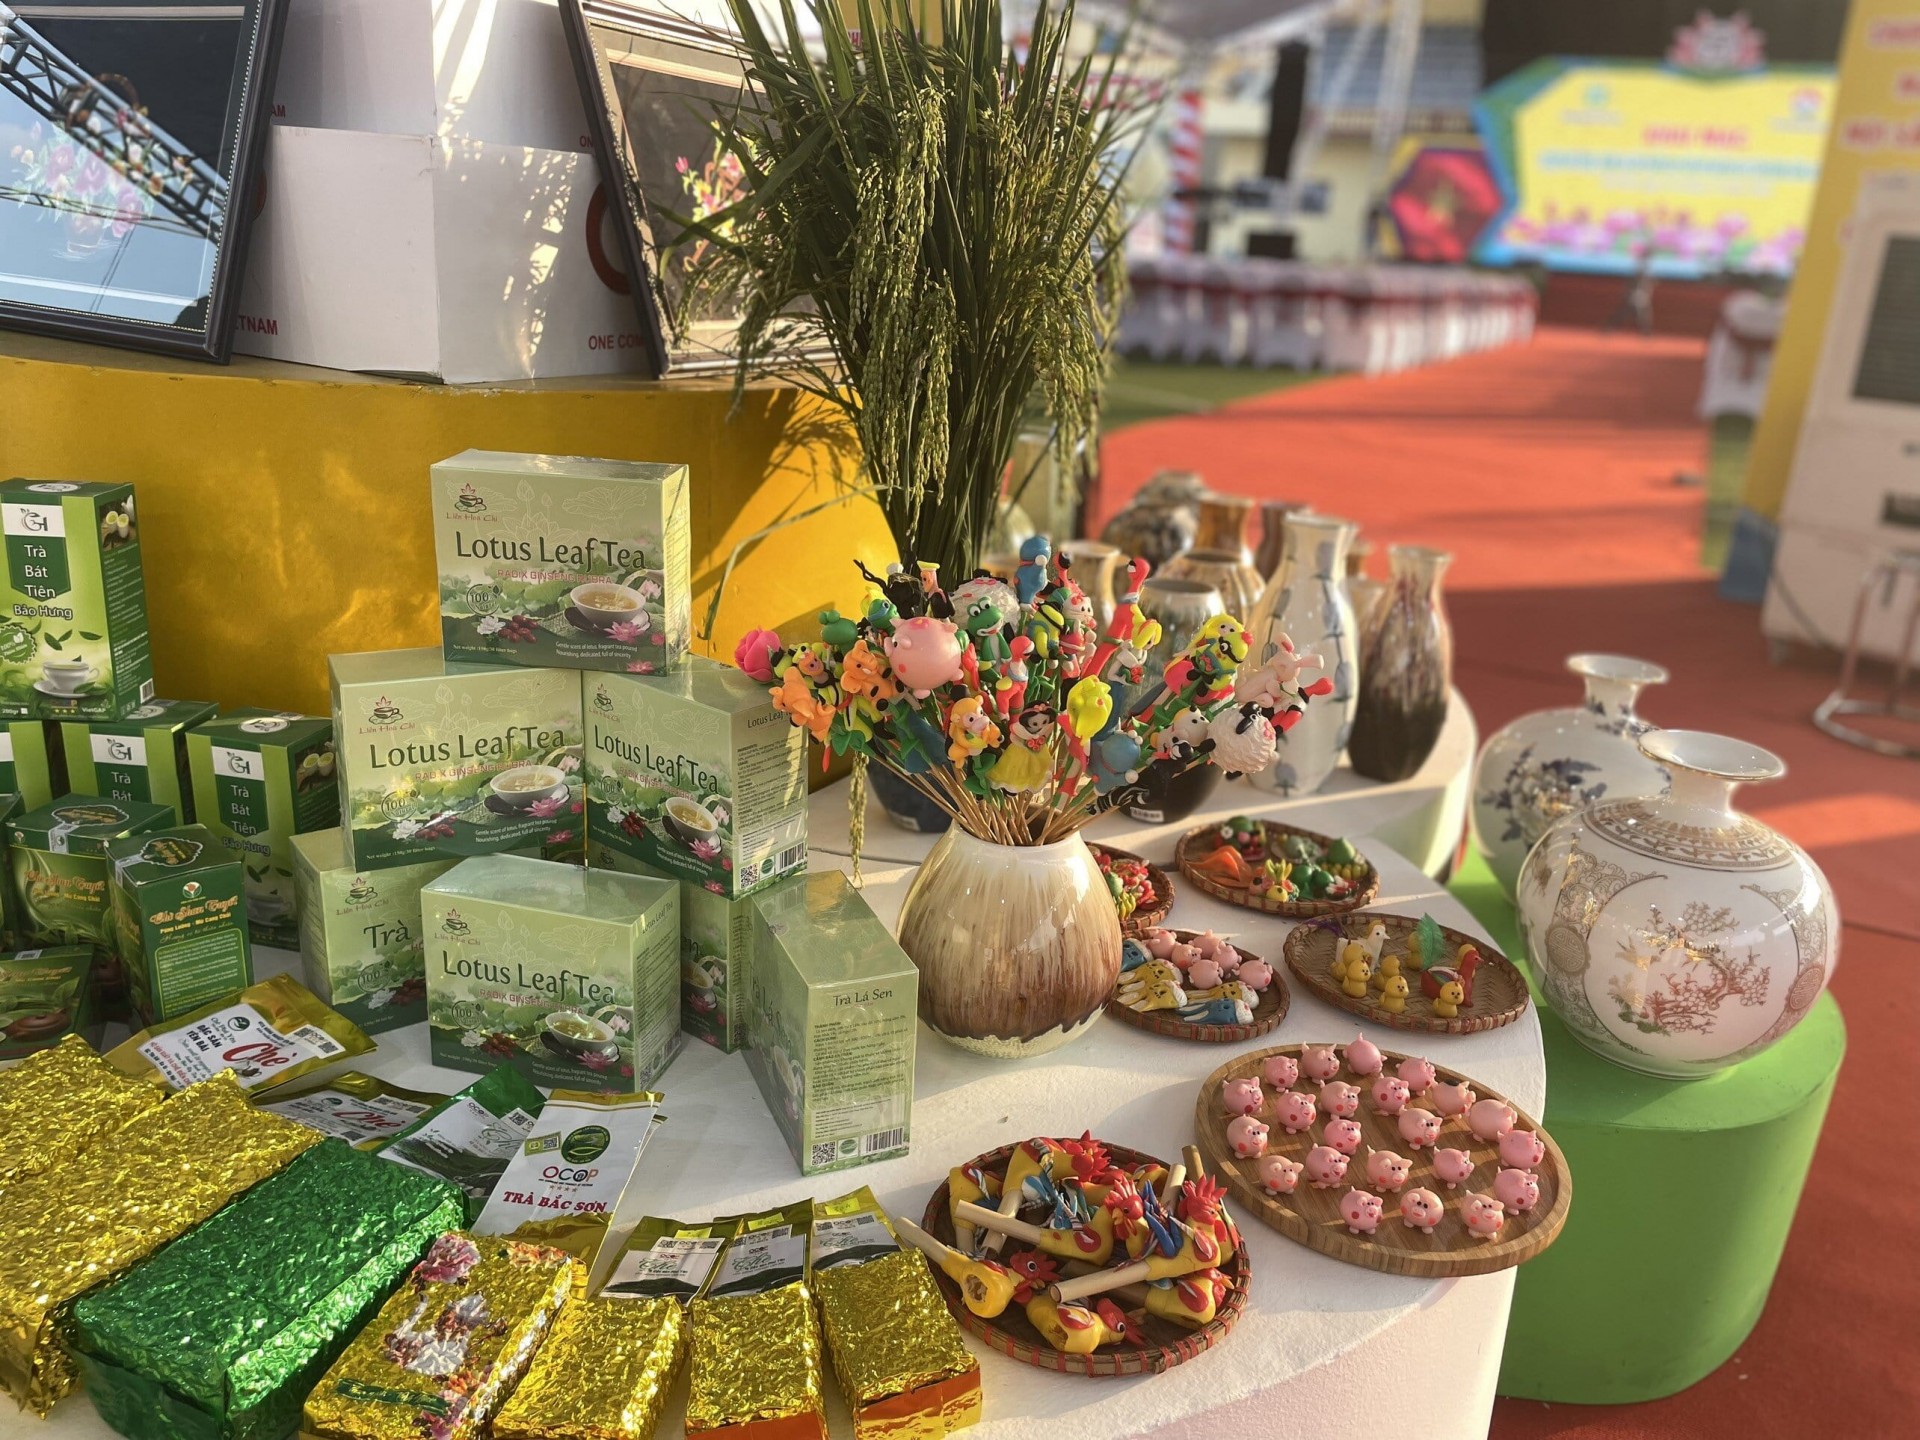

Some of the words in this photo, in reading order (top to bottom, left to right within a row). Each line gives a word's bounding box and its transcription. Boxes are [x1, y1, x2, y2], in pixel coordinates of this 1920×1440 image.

[237, 315, 278, 336] TNAM
[588, 336, 614, 350] ONE
[24, 544, 47, 558] Trà
[456, 531, 532, 561] Lotus
[540, 536, 598, 572] Leaf
[600, 541, 646, 569] Tea
[24, 564, 48, 578] Bát
[497, 570, 528, 578] RADIX
[530, 572, 576, 581] GINSENG
[24, 584, 56, 598] Tiên
[14, 604, 36, 616] Bảo
[38, 606, 73, 620] Hưng
[747, 716, 768, 728] Lotus
[370, 743, 450, 768] Lotus
[458, 726, 518, 760] Leaf
[520, 726, 565, 750] Tea
[594, 724, 641, 764] Lotus
[646, 744, 684, 786] Leaf
[686, 760, 718, 794] Tea
[111, 772, 131, 784] Trà
[230, 785, 249, 798] Trà
[231, 803, 250, 816] Bát
[231, 821, 257, 834] Tiên
[364, 920, 412, 949] Trà
[443, 950, 510, 984] Lotus
[518, 964, 572, 1001] Leaf
[573, 974, 615, 1004] Tea
[480, 989, 507, 1000] RADIX
[510, 993, 550, 1006] GINSENG
[833, 995, 851, 1006] Trà
[856, 991, 869, 1002] Lá
[872, 988, 893, 1000] Sen
[197, 1024, 212, 1036] ĐẶC
[208, 1034, 222, 1048] SẢN
[223, 1042, 298, 1067] Chè
[543, 1166, 598, 1182] OCOP
[503, 1191, 534, 1206] TRÀ
[538, 1194, 572, 1210] BẮC
[574, 1200, 607, 1212] SƠN
